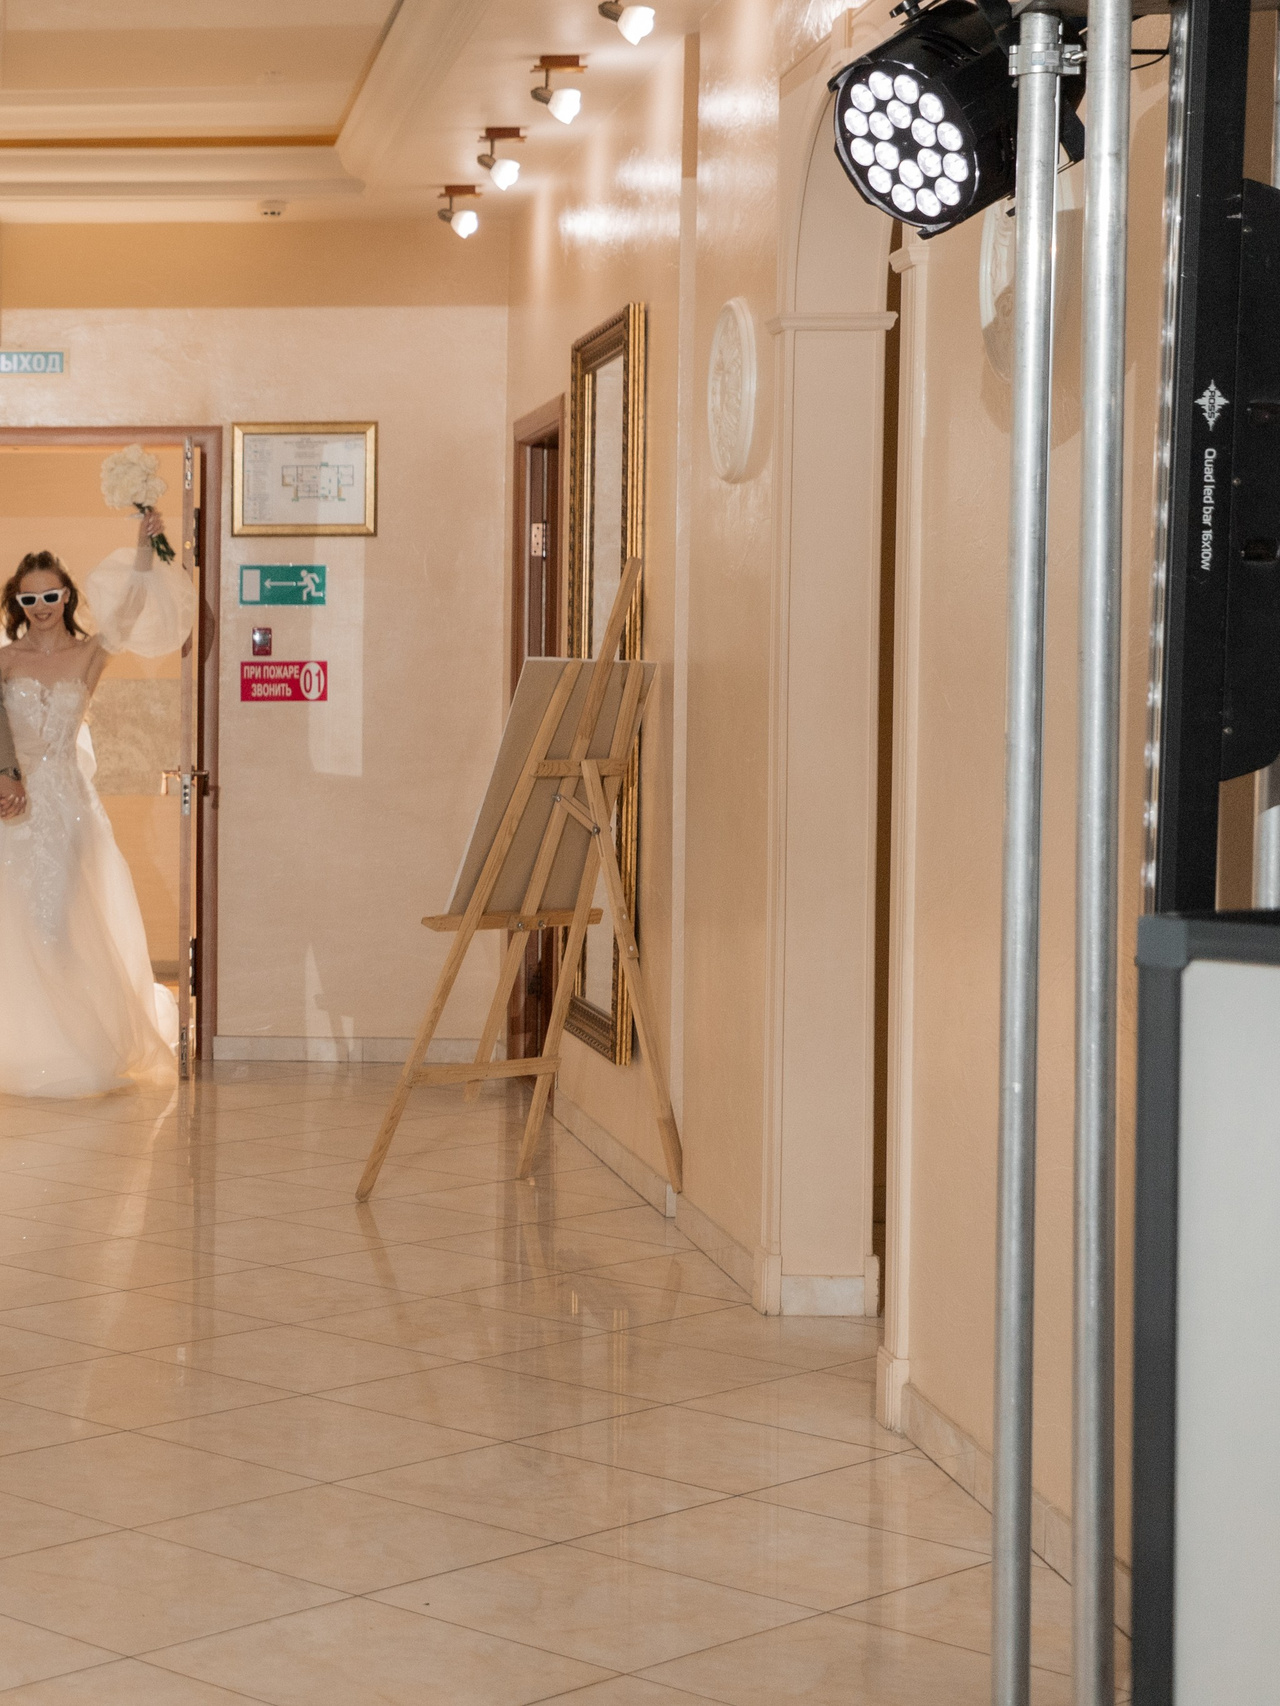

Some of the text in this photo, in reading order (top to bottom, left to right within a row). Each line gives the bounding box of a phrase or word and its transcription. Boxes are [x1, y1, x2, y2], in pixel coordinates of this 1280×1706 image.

[1207, 390, 1216, 419] ROSS
[1200, 448, 1217, 571] Quad led bar 16x10w
[244, 665, 300, 679] ПРИ ПОЖАРЕ
[303, 669, 321, 693] 01
[251, 683, 292, 697] ЗВОНИТЬ
